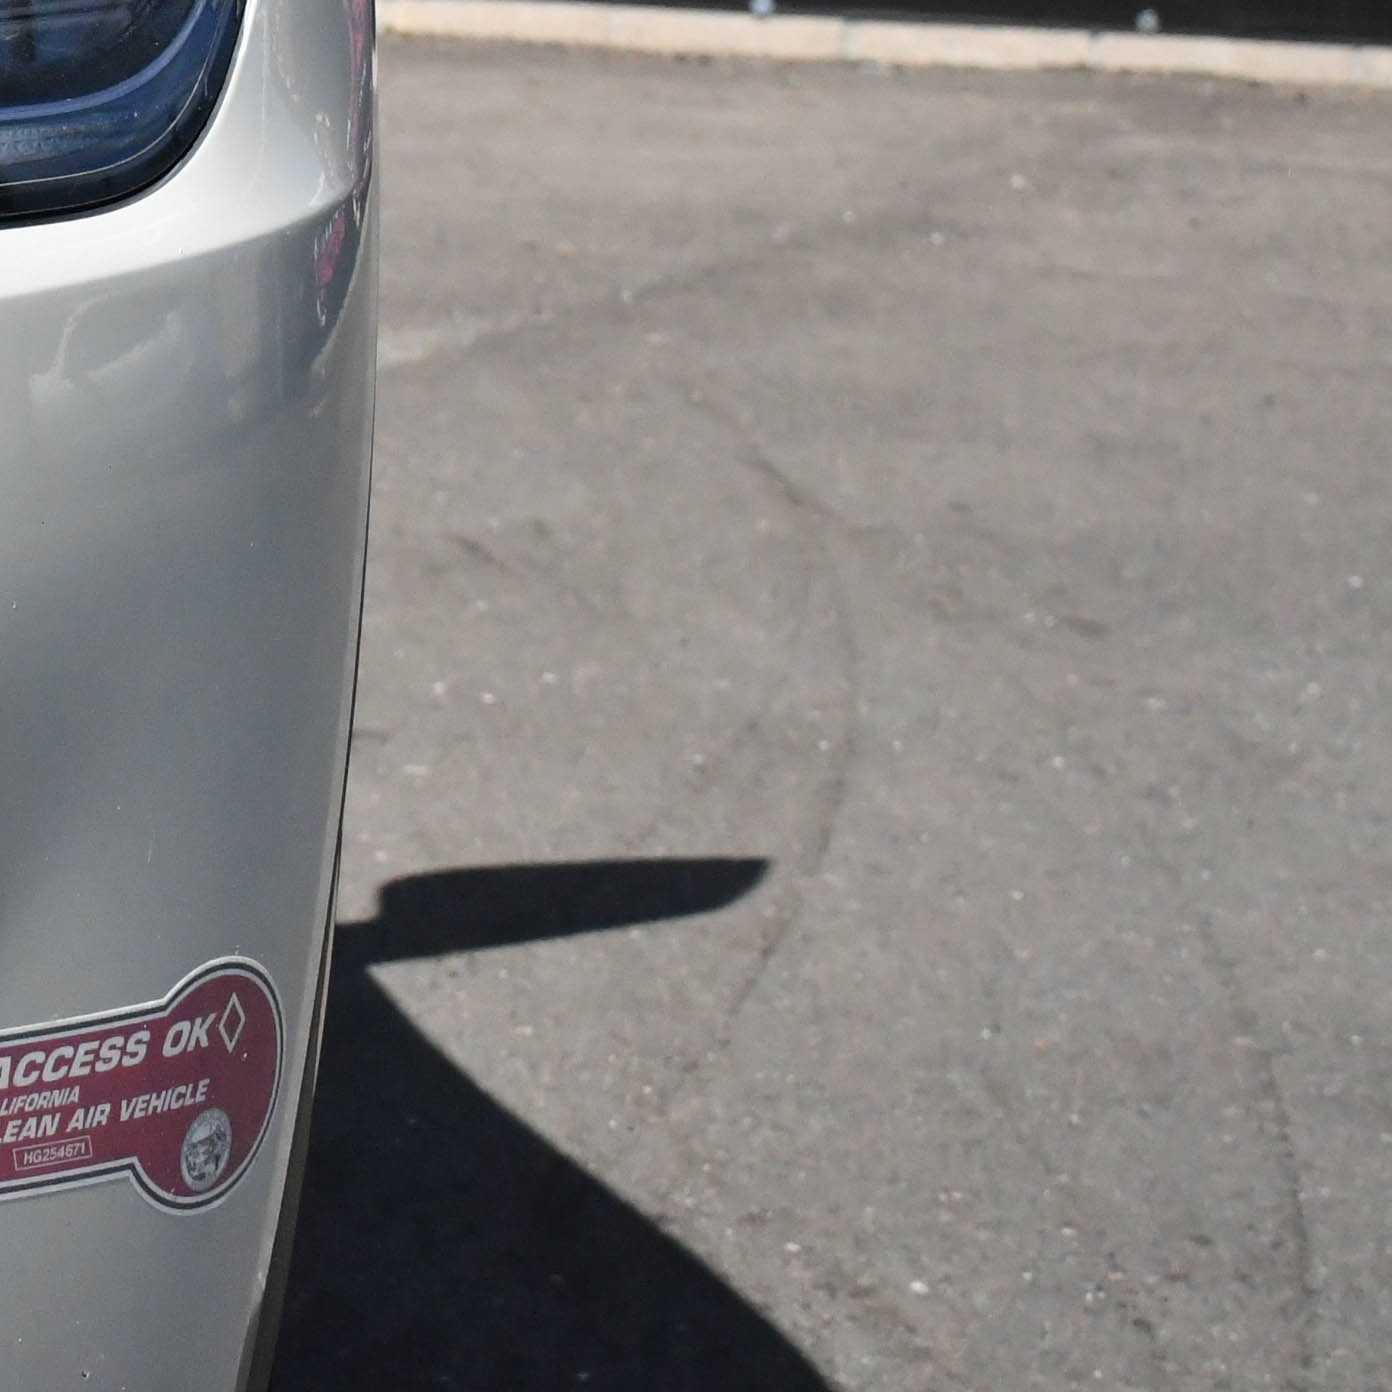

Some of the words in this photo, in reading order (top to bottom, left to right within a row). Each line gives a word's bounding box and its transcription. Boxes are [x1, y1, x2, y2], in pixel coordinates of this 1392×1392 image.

[161, 1012, 218, 1058] OK
[65, 1102, 112, 1134] AIR
[119, 1077, 211, 1123] VEHICLE
